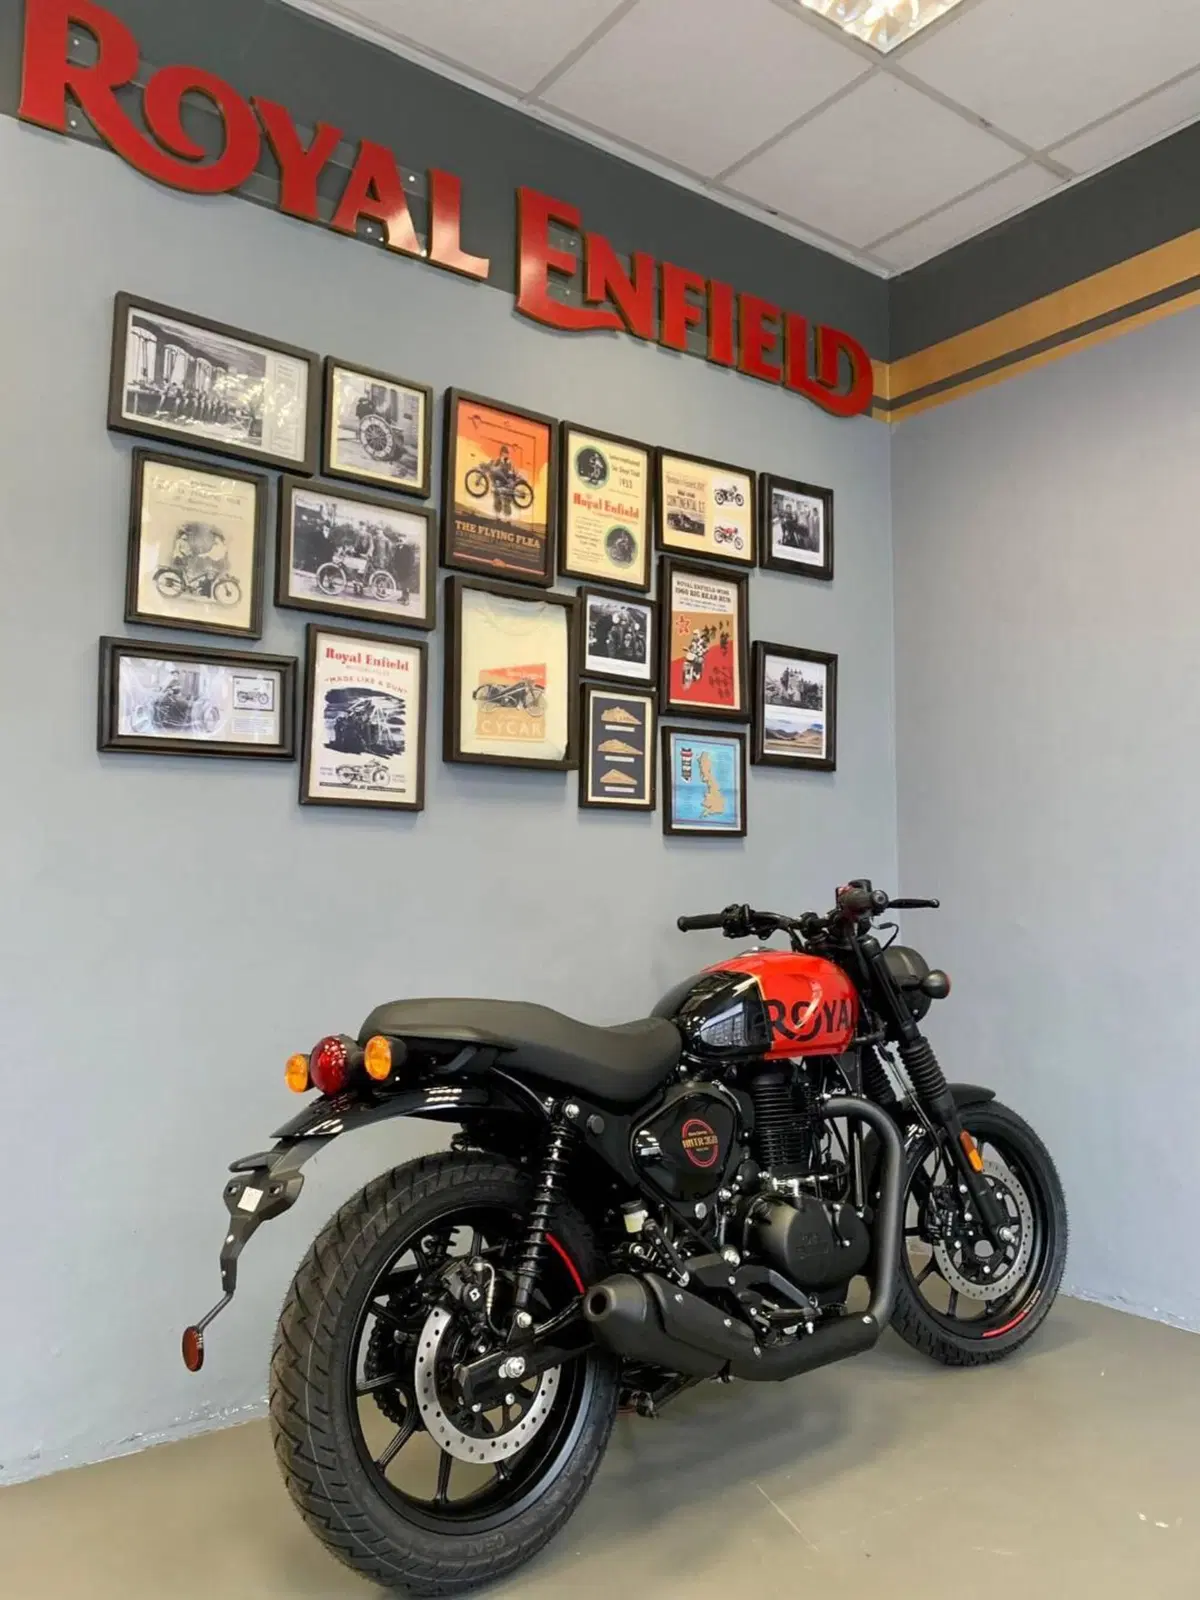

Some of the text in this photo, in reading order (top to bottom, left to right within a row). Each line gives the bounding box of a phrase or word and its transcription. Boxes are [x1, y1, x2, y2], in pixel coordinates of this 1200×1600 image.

[17, 0, 873, 417] ROYAL ENFIELD
[573, 492, 602, 510] Royal
[604, 499, 639, 519] Enfield
[454, 520, 541, 549] THE FLYING FLEA
[325, 647, 362, 664] Royal
[366, 654, 409, 671] Enfield
